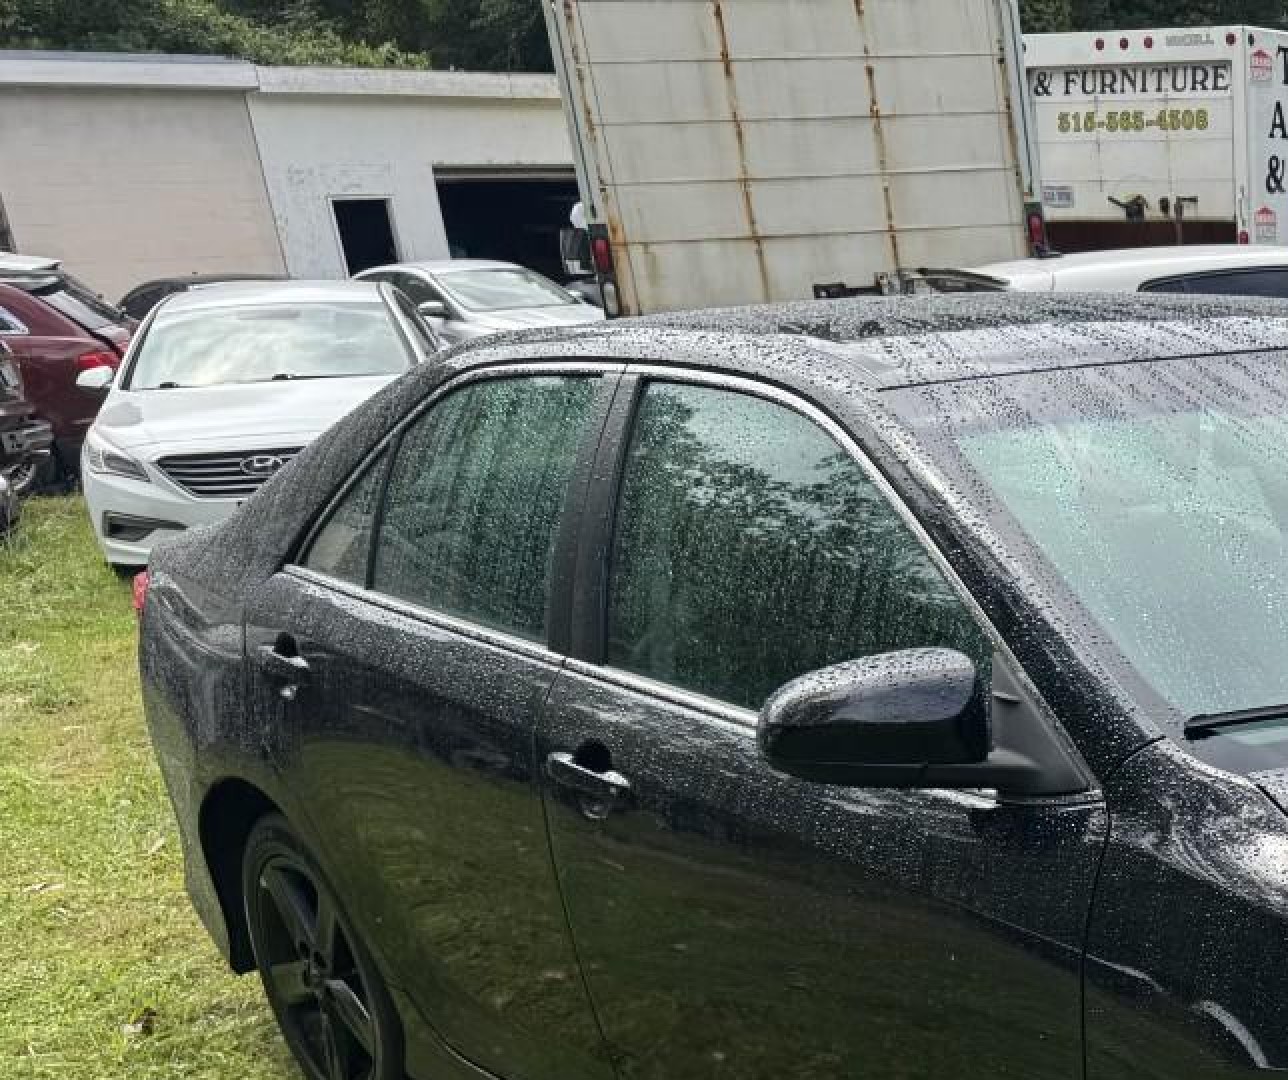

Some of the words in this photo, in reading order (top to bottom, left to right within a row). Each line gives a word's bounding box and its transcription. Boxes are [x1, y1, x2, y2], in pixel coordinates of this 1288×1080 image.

[1034, 71, 1053, 96] &
[1063, 66, 1230, 95] FURNITURE
[1265, 154, 1285, 194] &
